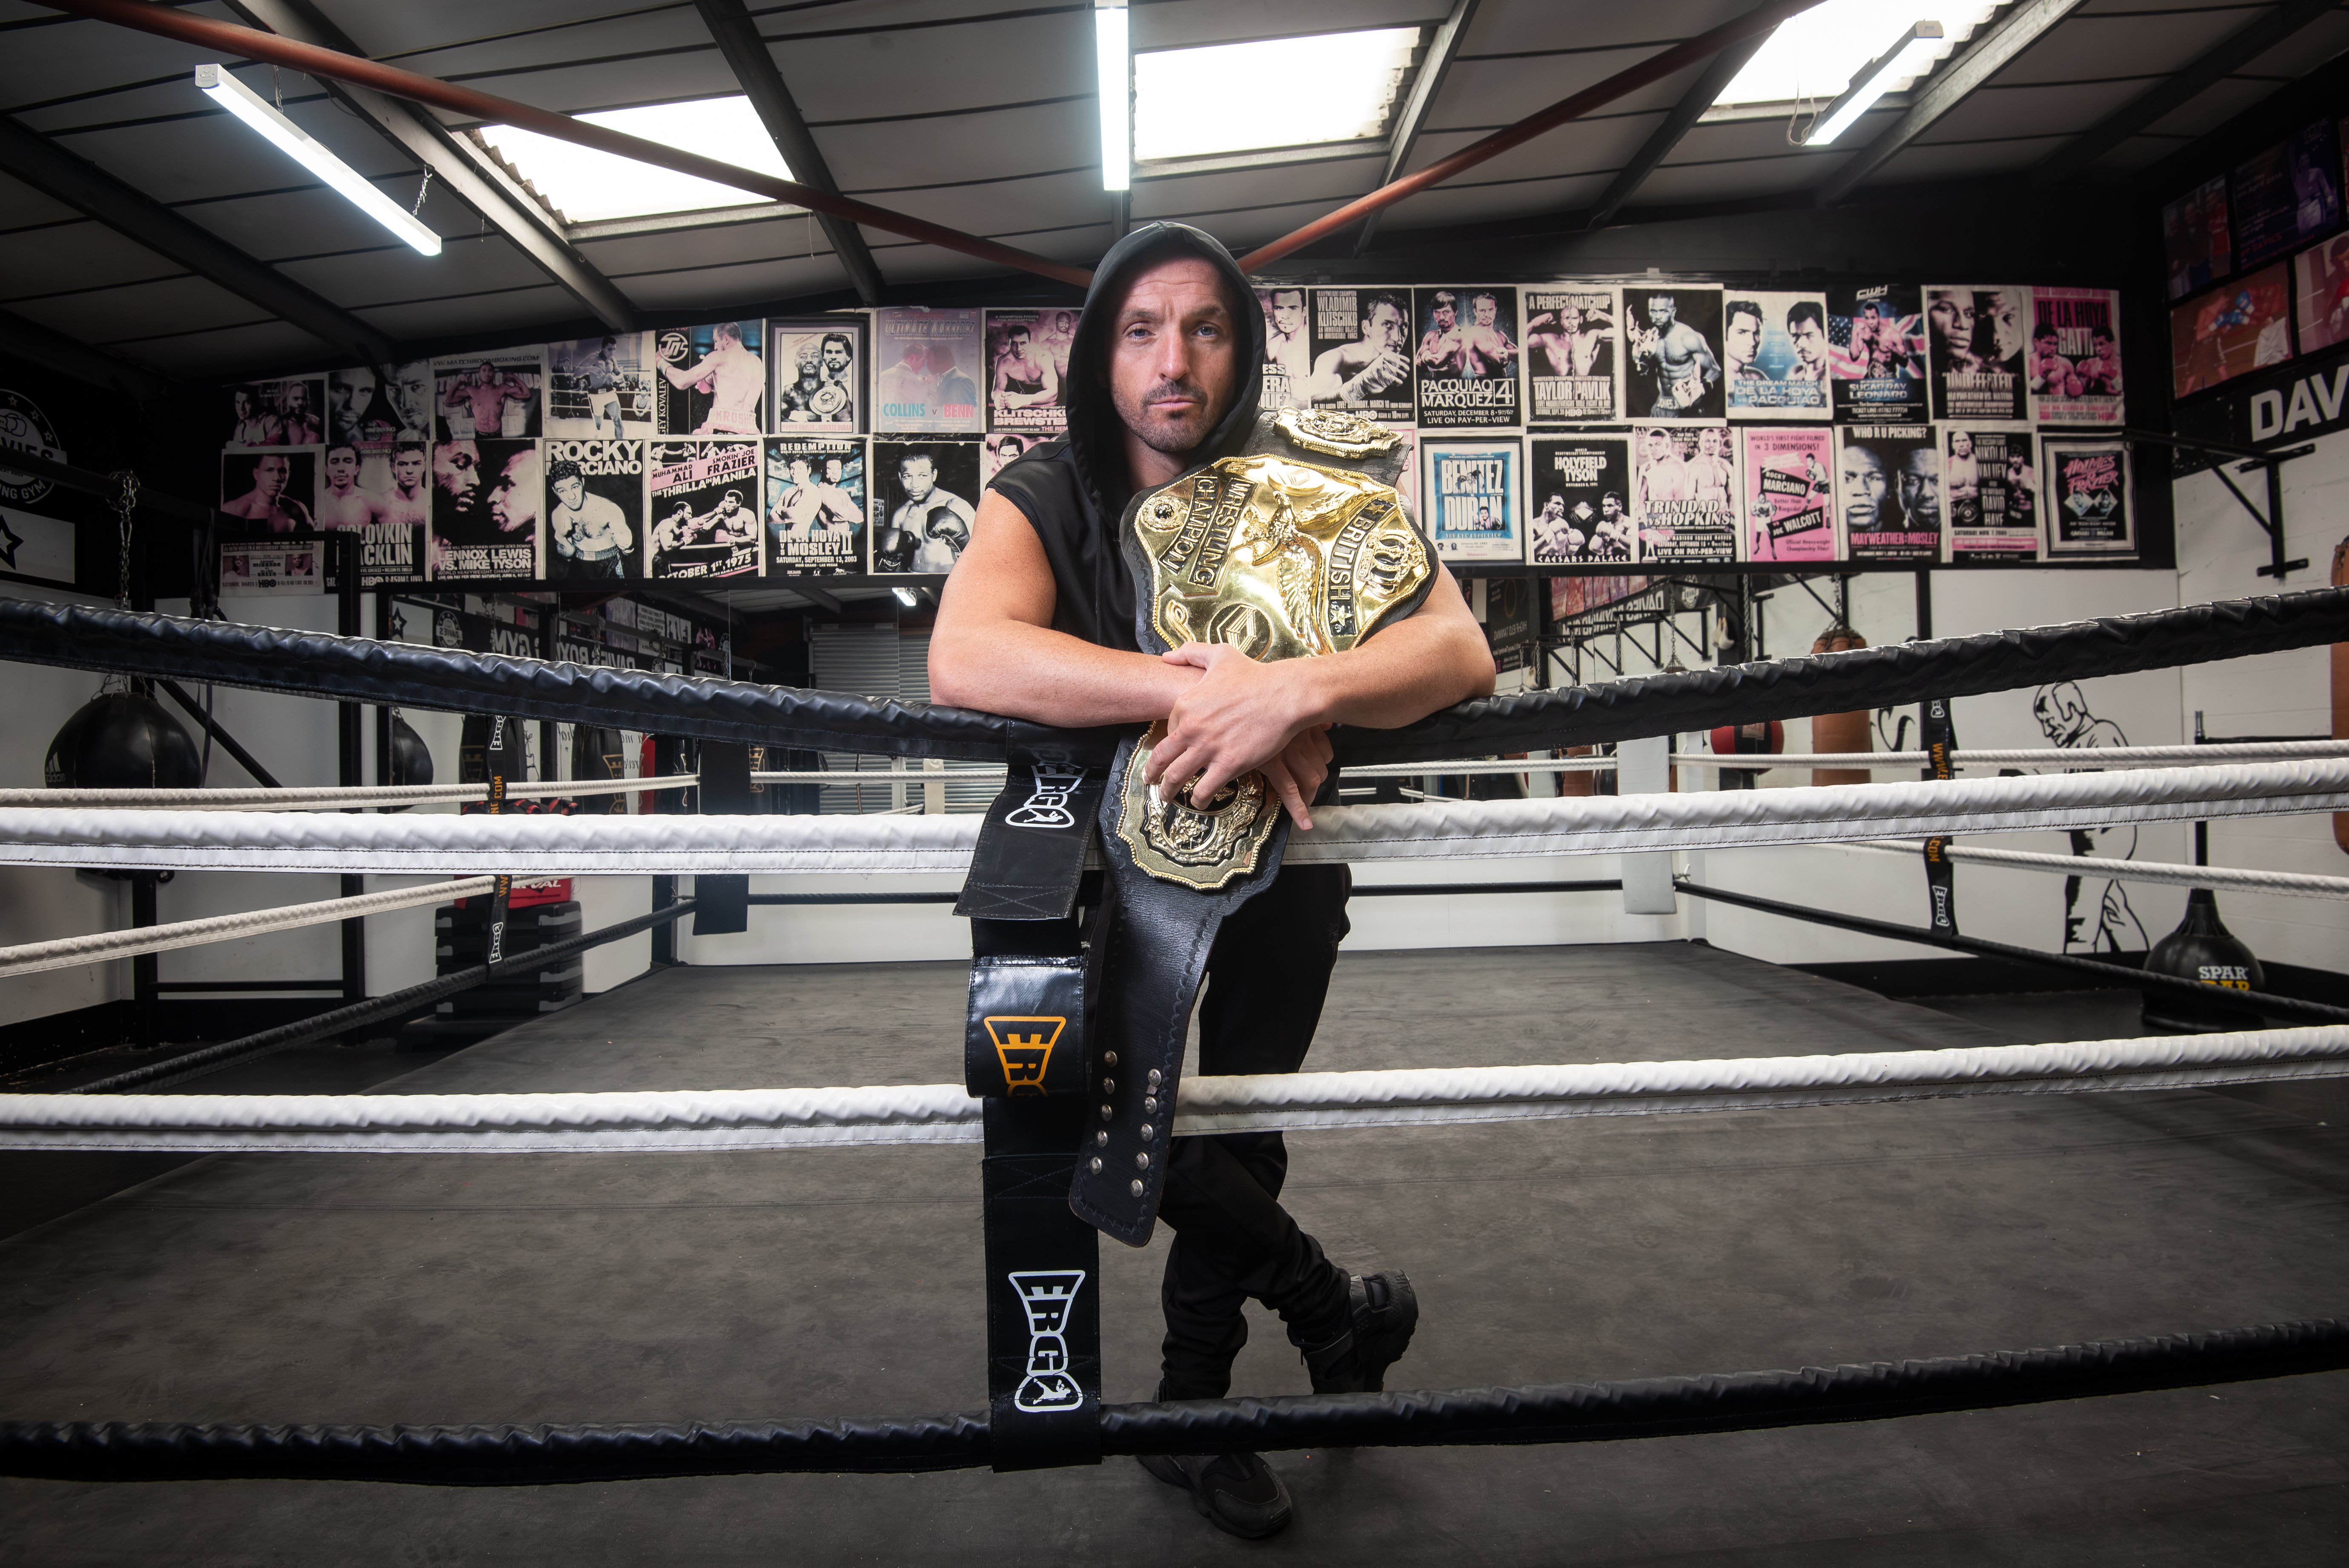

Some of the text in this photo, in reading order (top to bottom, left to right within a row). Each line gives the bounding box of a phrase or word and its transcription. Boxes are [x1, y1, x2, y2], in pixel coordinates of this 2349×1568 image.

[1317, 297, 1357, 311] WLADIMIR
[1529, 296, 1535, 309] A
[1571, 295, 1611, 309] MATCHUP
[1318, 311, 1358, 327] KLITSCHKO
[2057, 301, 2072, 327] LA
[885, 320, 928, 336] ULTIMATE
[1421, 379, 1513, 404] PACQUIAO 4
[1534, 381, 1611, 401] TAYLOR PAVLIK
[1736, 386, 1819, 395] DE LA HOYA
[1849, 383, 1884, 391] SUGAR
[659, 378, 667, 416] KOVALEV
[1421, 393, 1494, 408] MARQUEZ
[1849, 391, 1908, 399] LEONARD
[883, 403, 974, 418] COLLINS BENN
[1347, 400, 1369, 409] SATURDAY,
[1370, 400, 1384, 408] MARCH
[1385, 400, 1389, 408] 10
[1355, 410, 1378, 420] HBO
[1565, 409, 1583, 417] HBO
[1853, 426, 1927, 439] WHO R U PICKING?
[545, 440, 643, 461] ROCKY
[713, 449, 754, 464] SMOKIN' JOE
[1975, 446, 2007, 462] NIKOLAI
[707, 455, 755, 476] FRAZIER
[1555, 456, 1607, 470] HOLYFIELD
[652, 464, 693, 479] MUHAMMAD
[673, 470, 693, 483] ALI
[1441, 459, 1504, 494] BENITEZ
[1564, 469, 1598, 482] TYSON
[1765, 471, 1787, 480] ROCKY
[20, 479, 46, 500] GYM
[662, 480, 707, 498] THRILLA
[711, 467, 756, 486] MANILA
[1763, 478, 1806, 495] MARCIANO
[1644, 500, 1719, 513] TRINIDAD
[1982, 495, 2005, 511] DAVID
[1444, 496, 1503, 531] DURAN
[1661, 512, 1731, 525] HOPKINS
[1164, 478, 1215, 570] CHAMPION
[1773, 511, 1821, 536] JOE WALCOTT
[779, 529, 841, 543] DE LA HOYA
[1194, 478, 1254, 587] WRESTLING
[1851, 532, 1905, 545] MAYWEATHER
[1908, 532, 1939, 545] MOSLEY
[438, 548, 532, 561] LENNOX LEWIS
[788, 542, 840, 556] MOSLEY
[438, 558, 532, 571] VS. MIKE TYSON
[725, 552, 751, 569] 1975
[1329, 515, 1370, 600] BRITISH
[258, 579, 277, 588] HBO
[2198, 965, 2249, 980] SPAR
